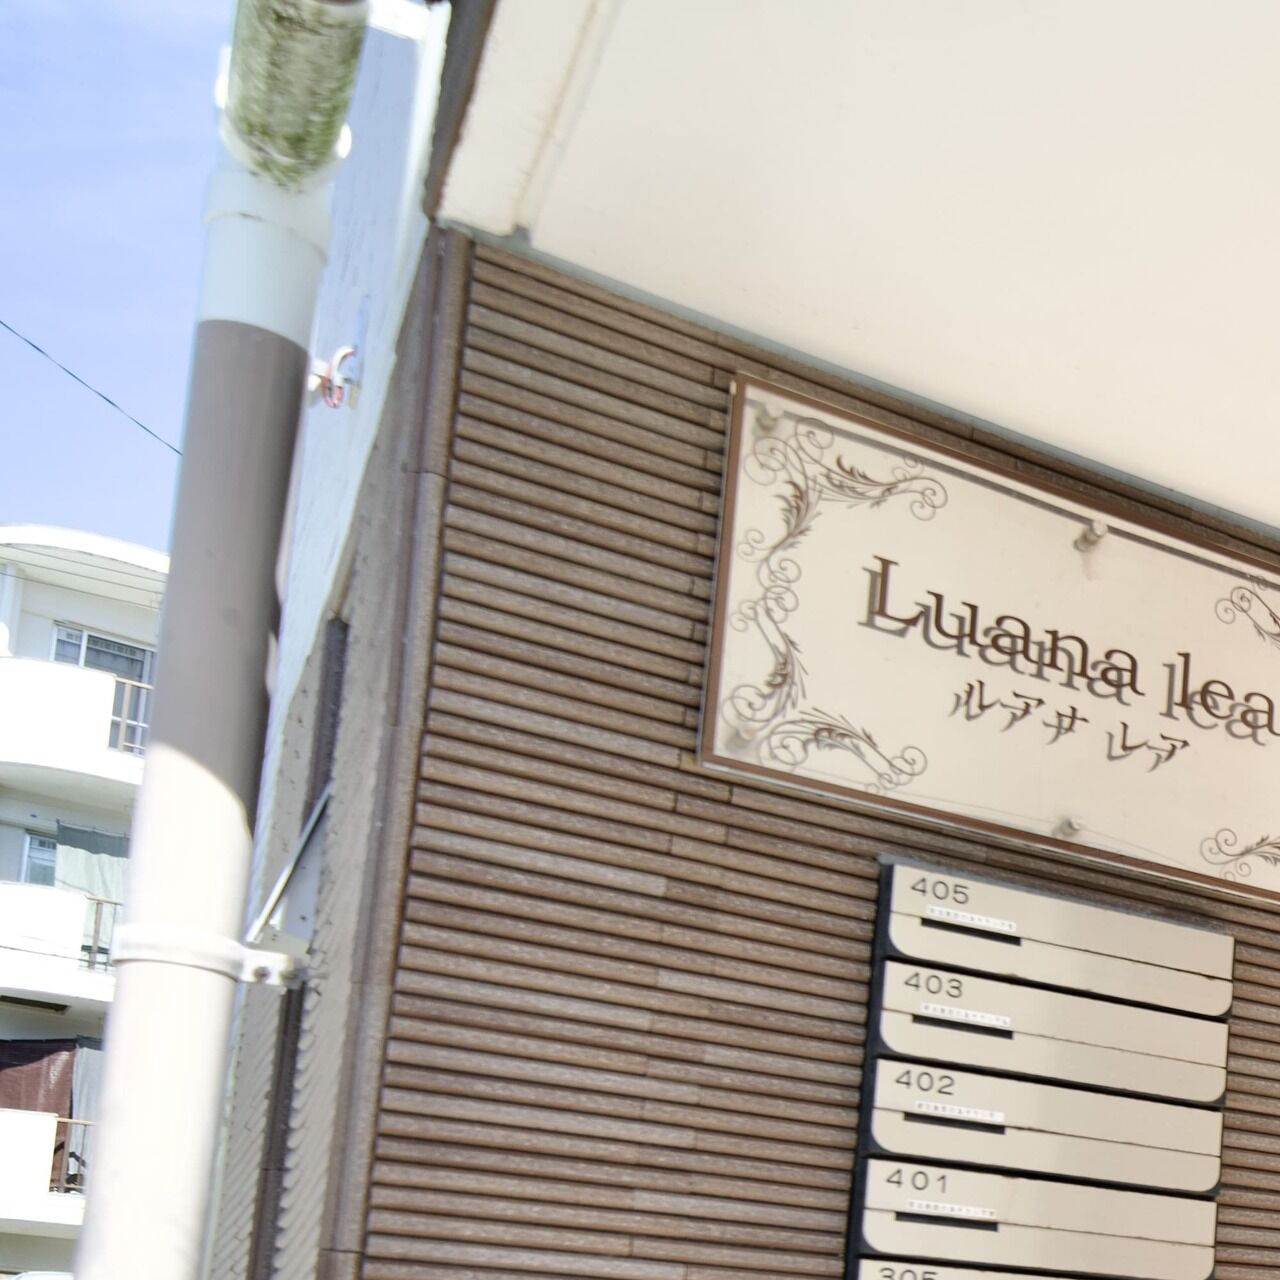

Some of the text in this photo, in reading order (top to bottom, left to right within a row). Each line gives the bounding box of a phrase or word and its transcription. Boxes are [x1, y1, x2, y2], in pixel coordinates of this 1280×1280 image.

[872, 555, 1146, 697] Luana
[964, 680, 1191, 763] ルアナ レア
[911, 878, 971, 905] 405
[904, 972, 964, 998] 403
[895, 1070, 956, 1095] 402
[886, 1169, 948, 1194] 401
